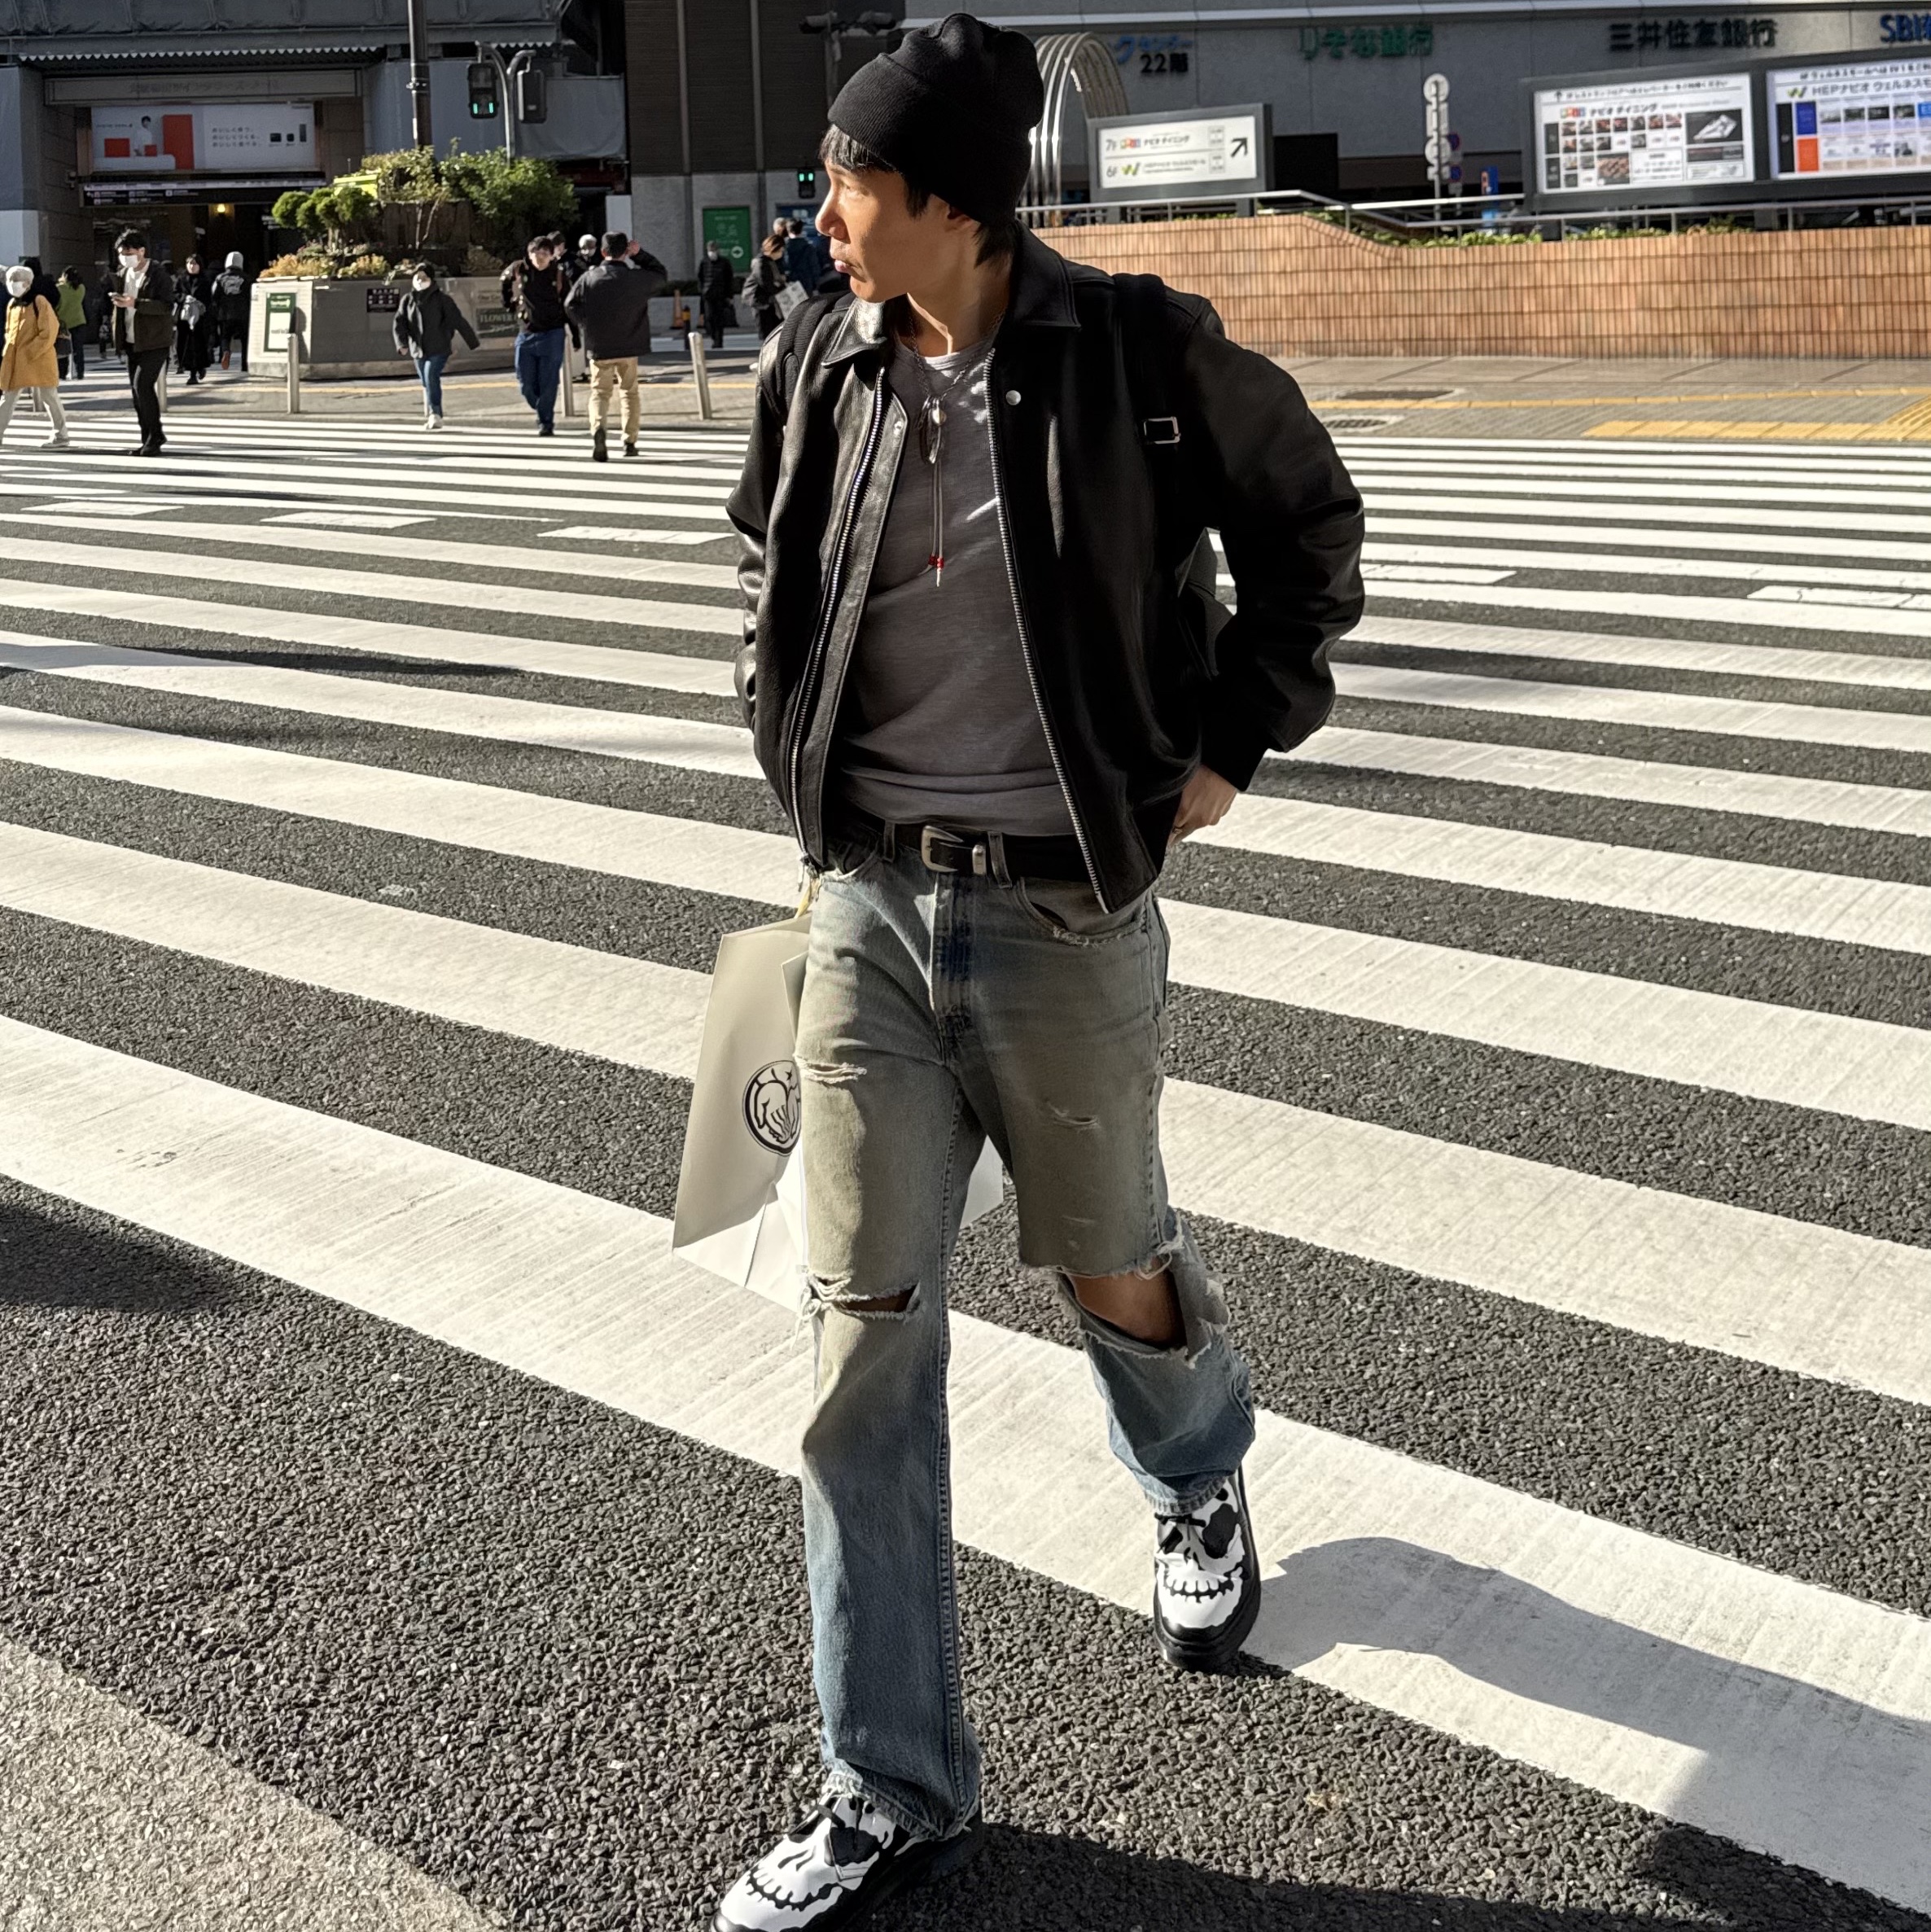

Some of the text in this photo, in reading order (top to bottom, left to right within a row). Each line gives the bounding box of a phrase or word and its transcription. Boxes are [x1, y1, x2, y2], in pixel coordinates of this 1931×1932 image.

[1299, 24, 1433, 60] りそな銀行
[1609, 18, 1776, 52] 三井住友銀行
[1141, 52, 1188, 72] 22階
